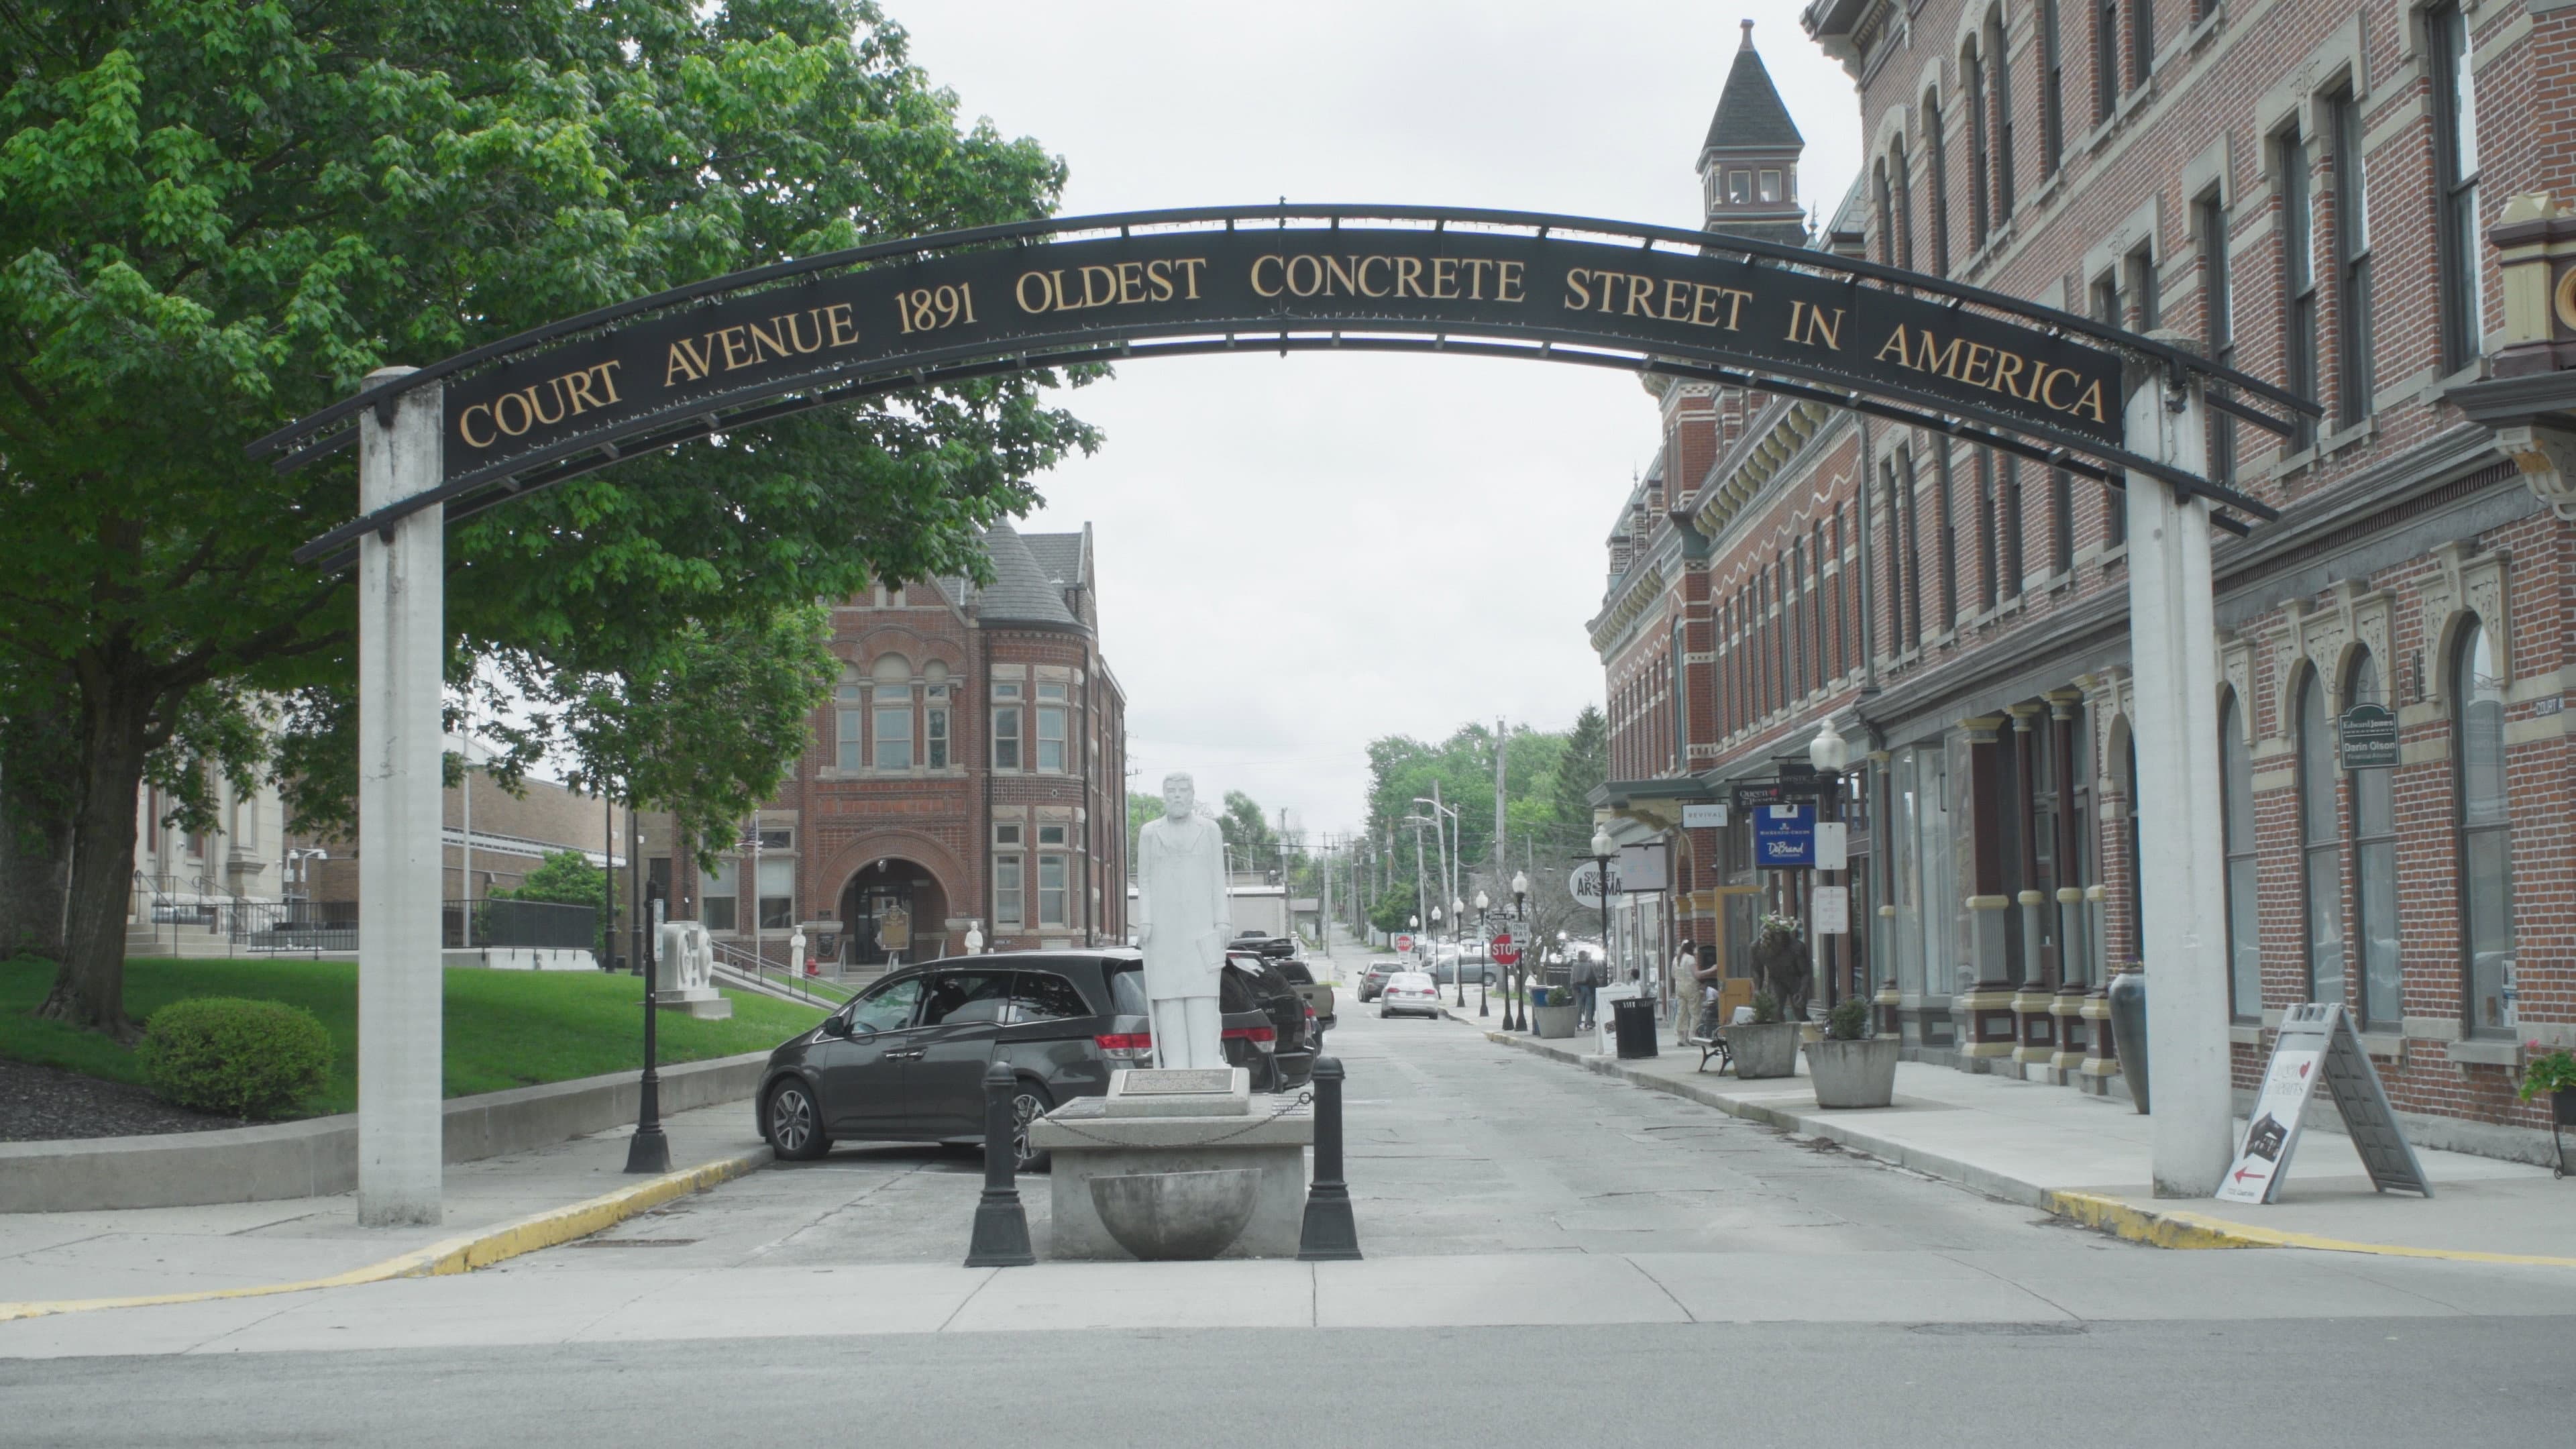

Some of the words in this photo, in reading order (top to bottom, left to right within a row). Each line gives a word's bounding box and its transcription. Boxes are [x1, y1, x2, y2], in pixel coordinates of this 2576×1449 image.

[458, 359, 623, 449] COURT
[663, 302, 860, 387] AVENUE
[894, 281, 978, 335] 1891
[1015, 257, 1207, 315] OLDEST
[1250, 255, 1525, 303] CONCRETE
[1564, 268, 1753, 331] STREET
[1784, 300, 1846, 352] IN
[1875, 322, 2107, 424] AMERICA
[2536, 698, 2557, 716] COURT
[2371, 719, 2394, 728] Jones
[2345, 742, 2368, 752] Darin
[2369, 741, 2395, 751] Olson
